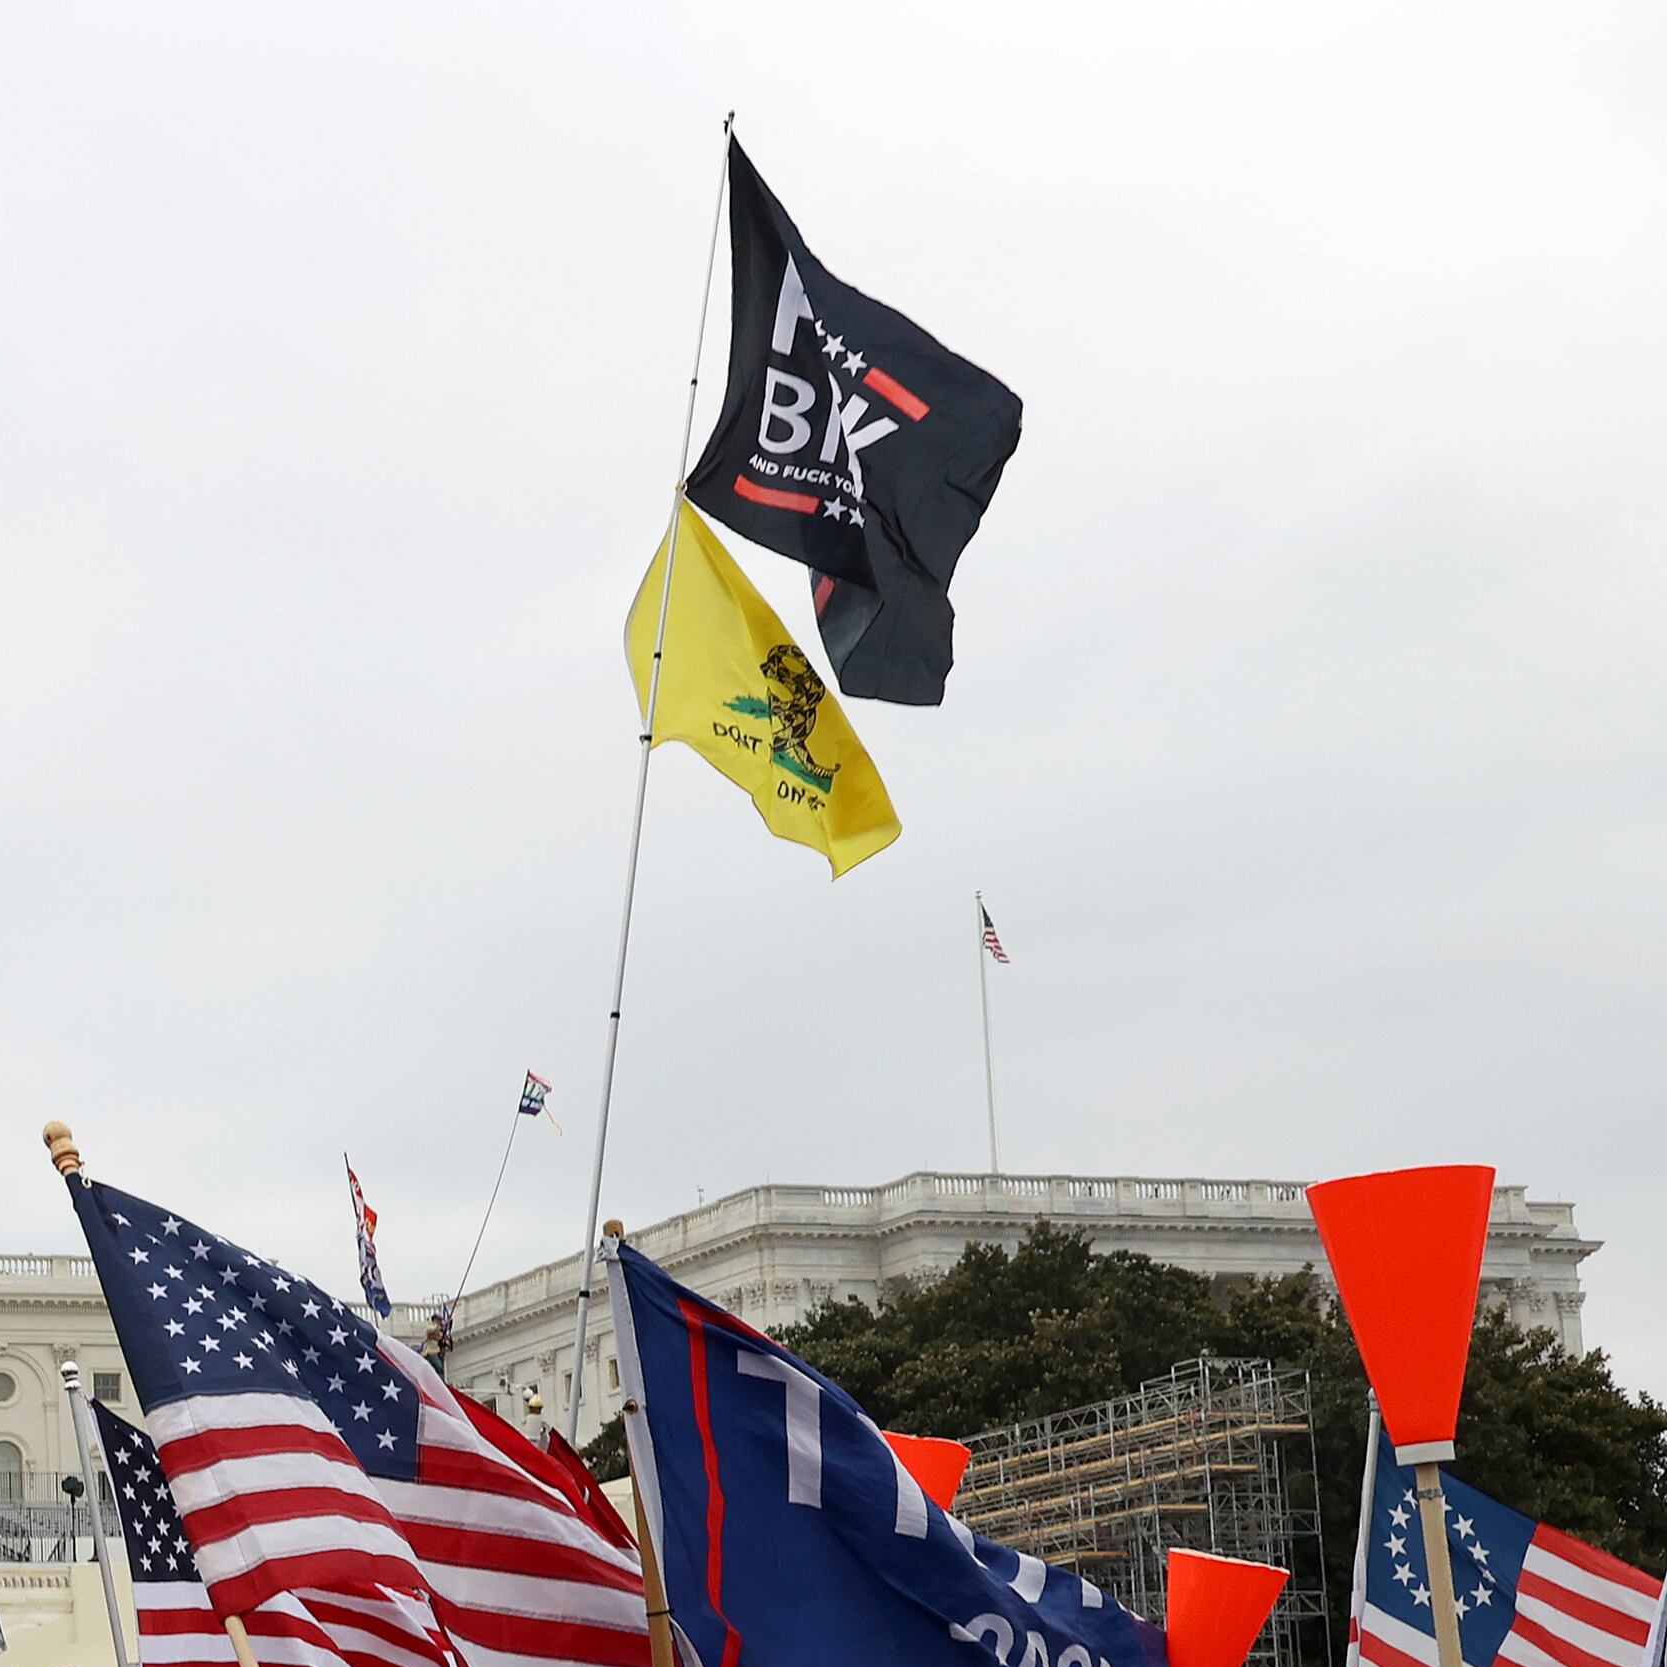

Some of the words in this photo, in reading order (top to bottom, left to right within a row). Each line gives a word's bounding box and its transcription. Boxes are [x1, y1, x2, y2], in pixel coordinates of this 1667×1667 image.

[749, 453, 782, 477] AND
[782, 464, 832, 486] FUCK
[777, 780, 807, 805] ON
